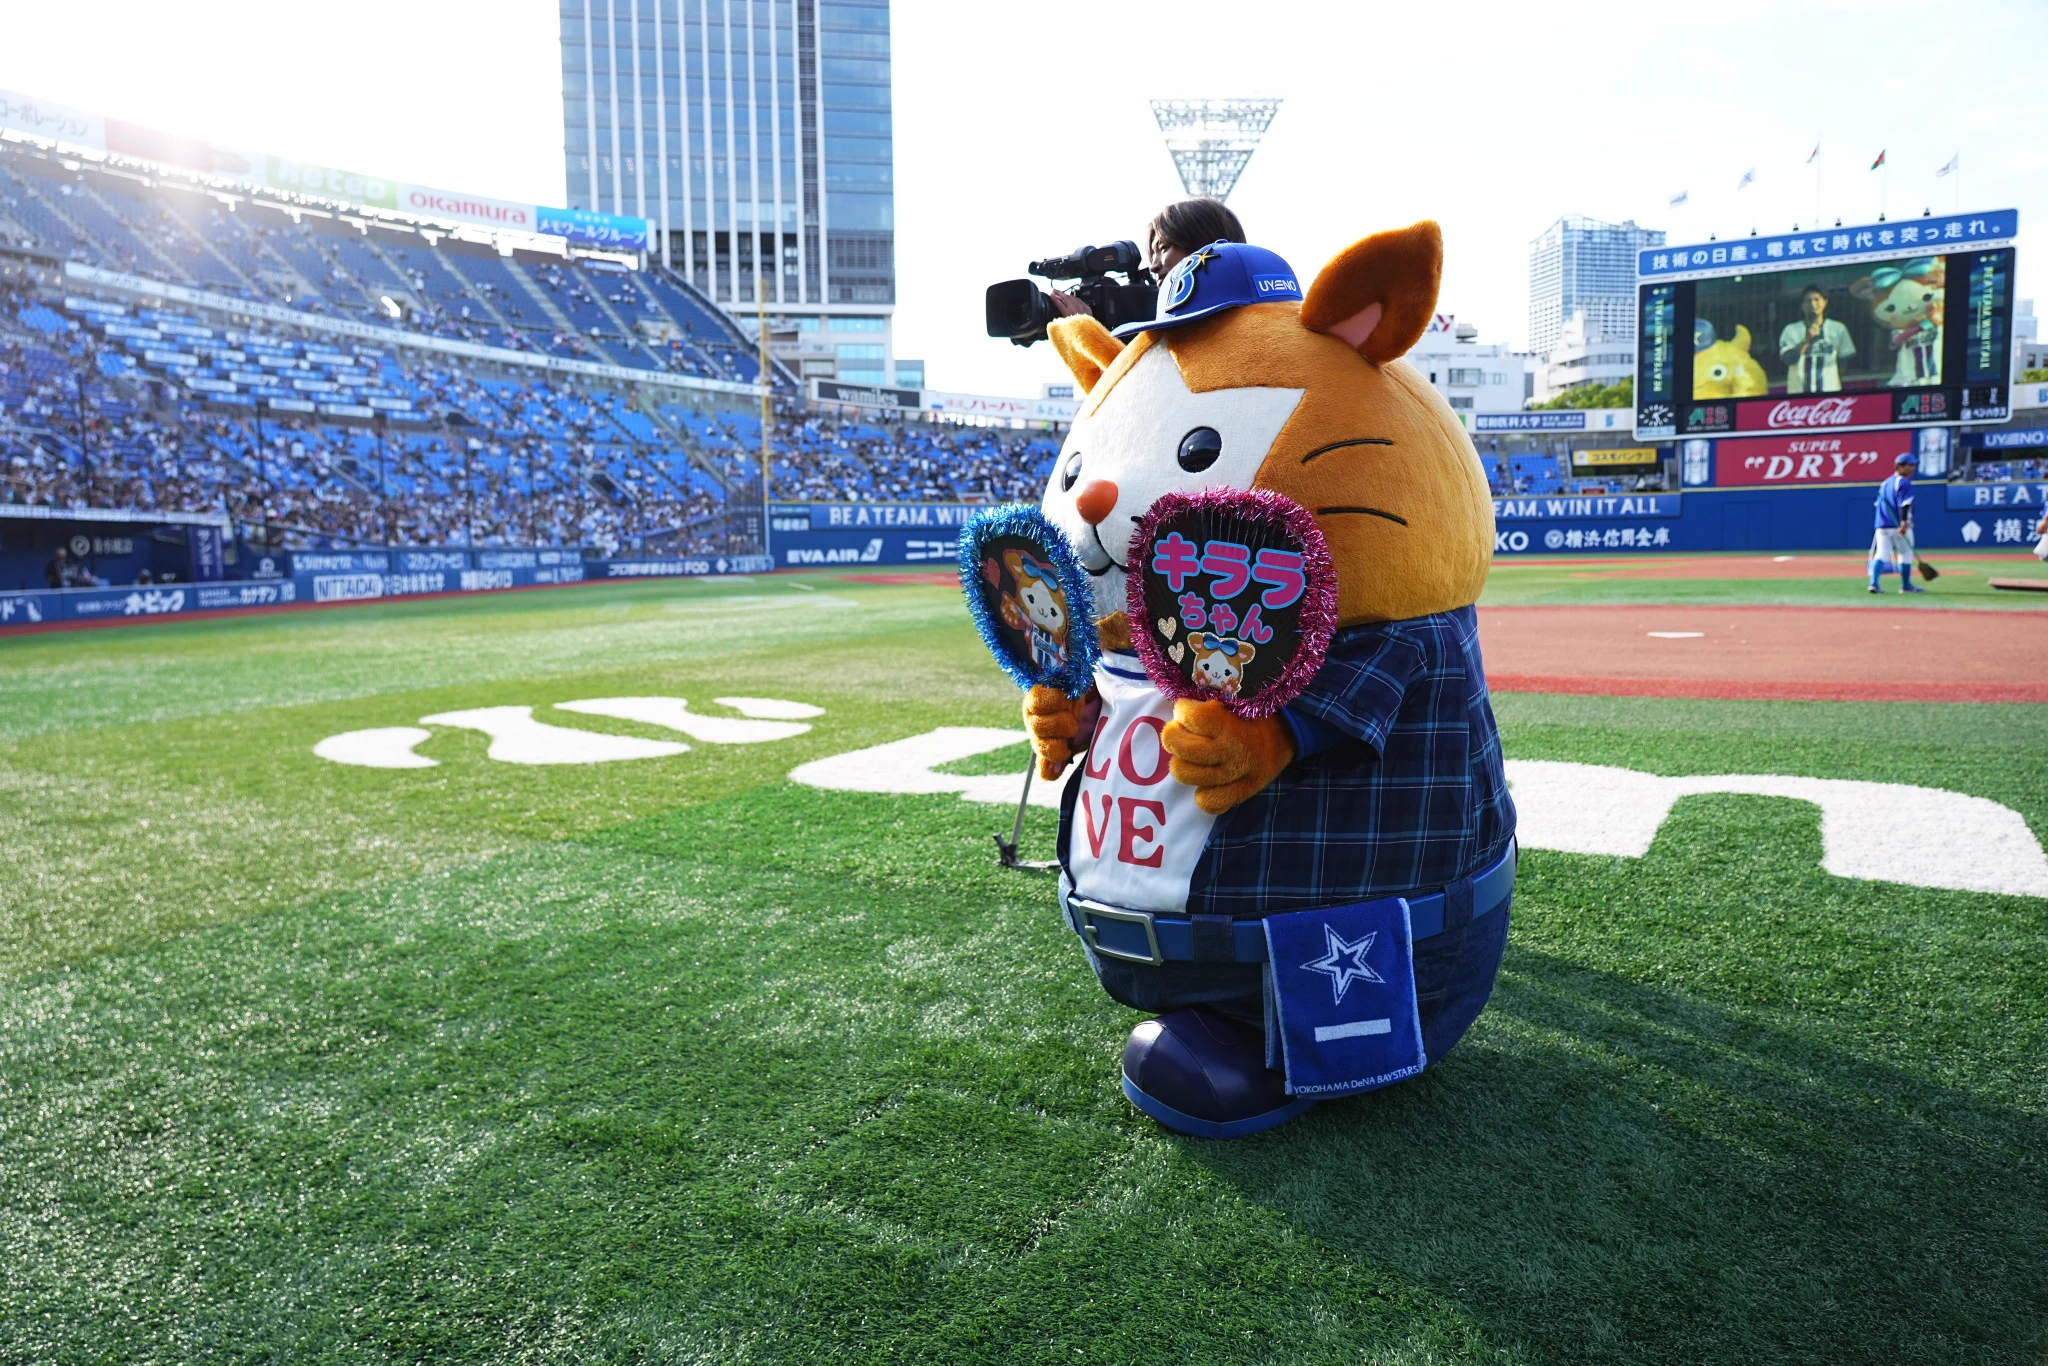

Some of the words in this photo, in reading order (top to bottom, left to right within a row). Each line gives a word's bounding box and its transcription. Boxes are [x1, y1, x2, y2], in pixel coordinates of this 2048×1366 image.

[1652, 219, 2001, 270] 技術の日産。電気で時代を突っ走れ。
[1258, 280, 1297, 292] UYENO
[836, 386, 899, 407] wamiles
[1767, 398, 1858, 428] Coca-Cola
[1787, 440, 1842, 453] SUPER
[1974, 486, 2007, 505] BE
[2012, 485, 2032, 504] A
[829, 506, 849, 525] BE
[856, 506, 871, 525] A
[1494, 500, 1543, 517] EAM.
[1546, 499, 1590, 516] WIN
[1597, 498, 1618, 515] IT
[1620, 497, 1660, 515] ALL
[1564, 527, 1671, 548] 横浜信用金庫
[1152, 531, 1306, 610] キララ
[1177, 591, 1274, 644] ちゃん
[1294, 1080, 1350, 1094] YOKOHAMA
[1351, 1077, 1376, 1088] DeNA
[1377, 1064, 1420, 1083] BAYSTARS
